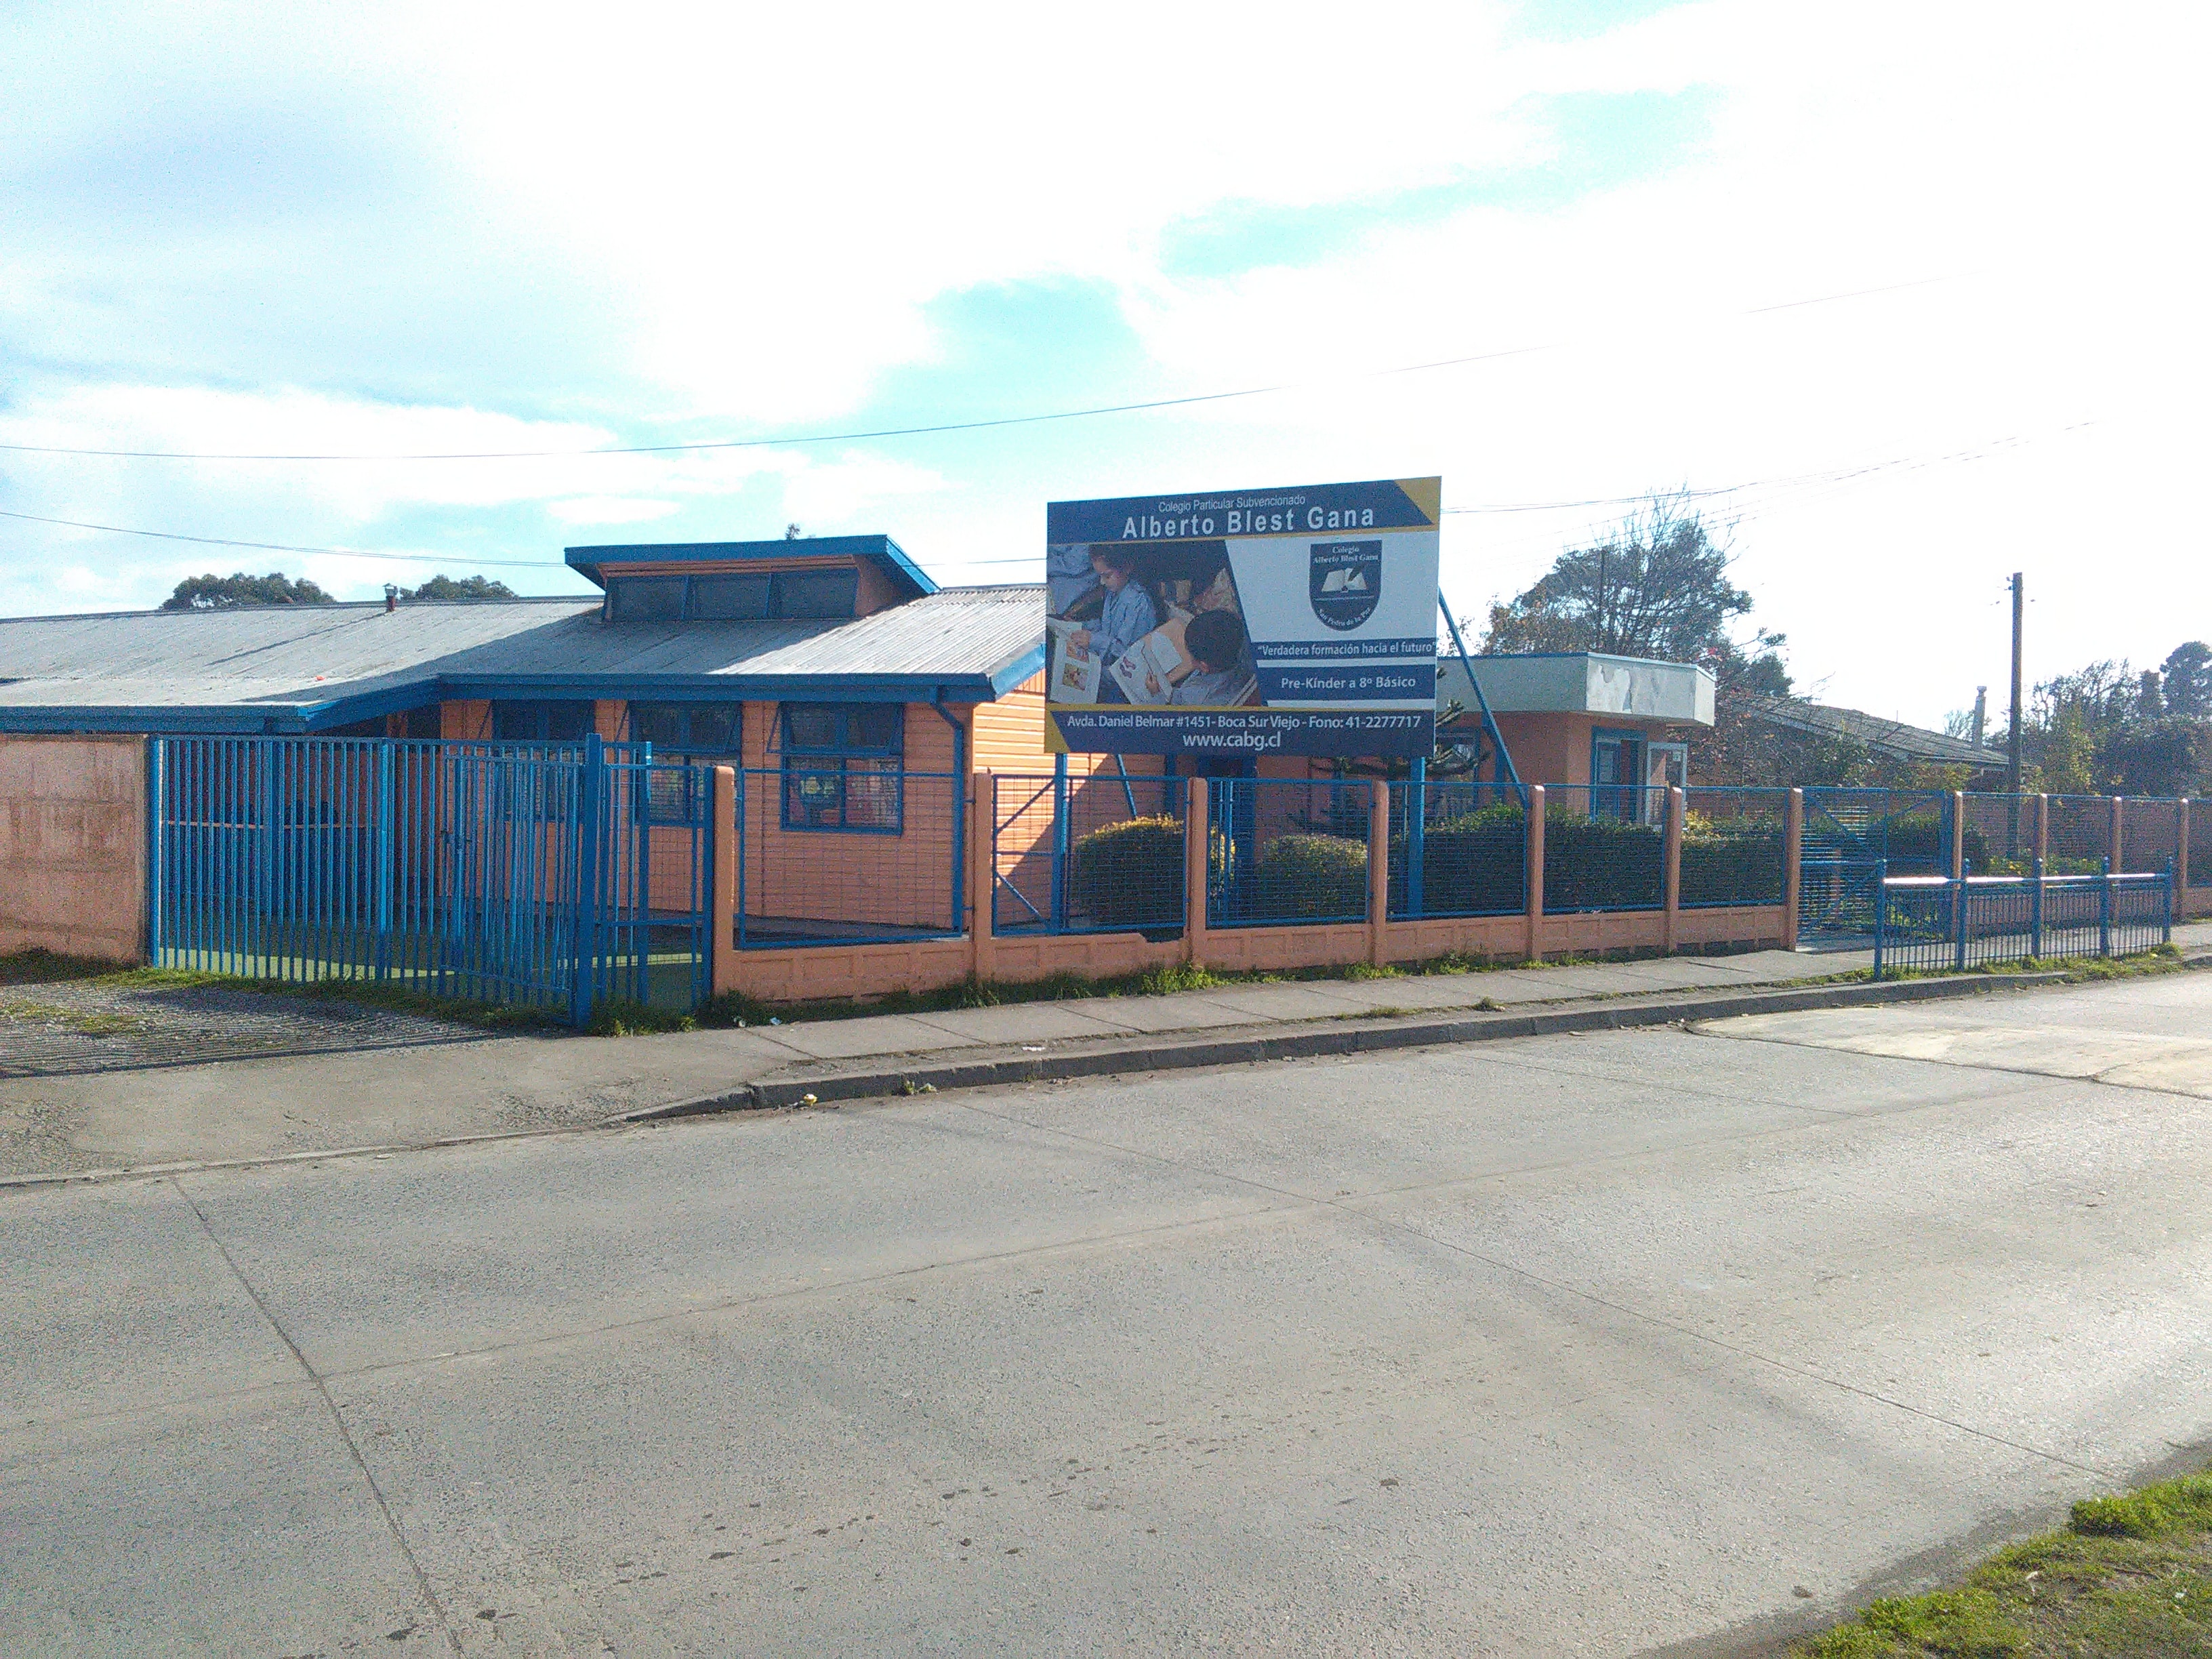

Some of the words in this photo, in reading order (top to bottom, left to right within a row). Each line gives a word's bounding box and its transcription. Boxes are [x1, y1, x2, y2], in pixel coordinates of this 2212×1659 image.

[1158, 500, 1191, 514] Colegio
[1193, 497, 1235, 511] Particular
[1236, 494, 1306, 508] Subvencionado
[1122, 514, 1214, 539] Alberto
[1227, 509, 1294, 533] Blest
[1307, 506, 1374, 529] Gana
[1332, 546, 1359, 554] Colegio
[1311, 643, 1359, 655] formación
[1361, 642, 1388, 654] hacia
[1390, 641, 1399, 653] el
[1349, 679, 1356, 689] a
[1376, 676, 1416, 689] Básico
[1067, 716, 1097, 727] Avda.
[1099, 716, 1134, 727] Daniel
[1134, 716, 1175, 727] Belmar
[1218, 716, 1247, 727] Boca
[1248, 716, 1268, 728] Sur
[1269, 716, 1300, 731] Viejo
[1309, 716, 1345, 729] Fono:
[1345, 716, 1421, 729] 41-2277717
[1183, 730, 1282, 751] www.cabg.cl
